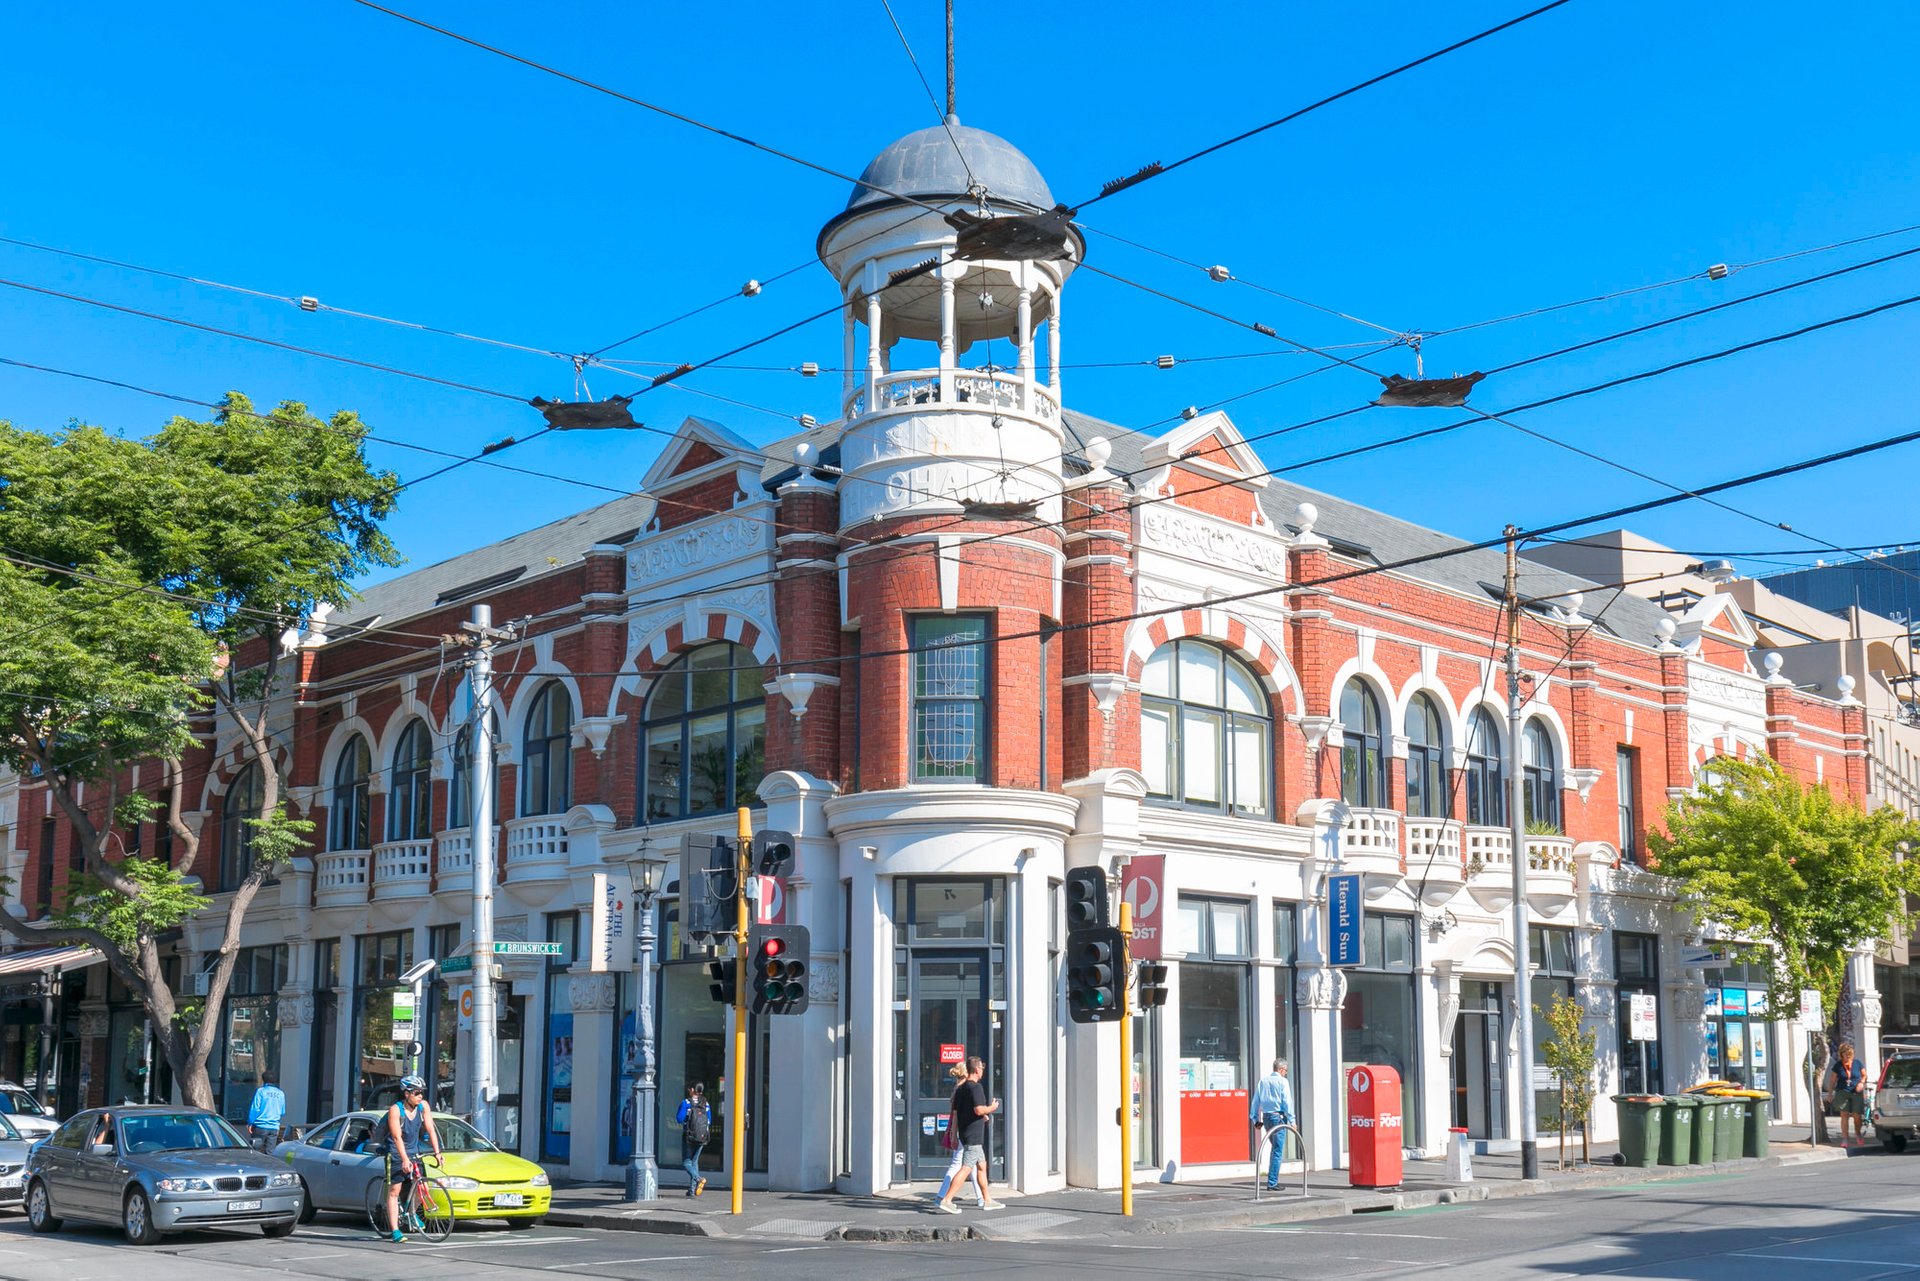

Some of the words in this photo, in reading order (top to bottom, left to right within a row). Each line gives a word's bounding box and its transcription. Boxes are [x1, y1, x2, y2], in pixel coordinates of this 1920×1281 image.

[1339, 880, 1350, 927] Herald
[604, 883, 616, 963] AUSTRALIAN
[614, 912, 622, 938] THE
[1132, 927, 1157, 940] OST
[507, 943, 549, 953] BRUNSWICK
[551, 944, 560, 953] ST
[1339, 932, 1350, 961] Sun
[942, 1051, 963, 1060] CLOSED
[1351, 1118, 1375, 1127] POST
[1380, 1116, 1402, 1128] POST
